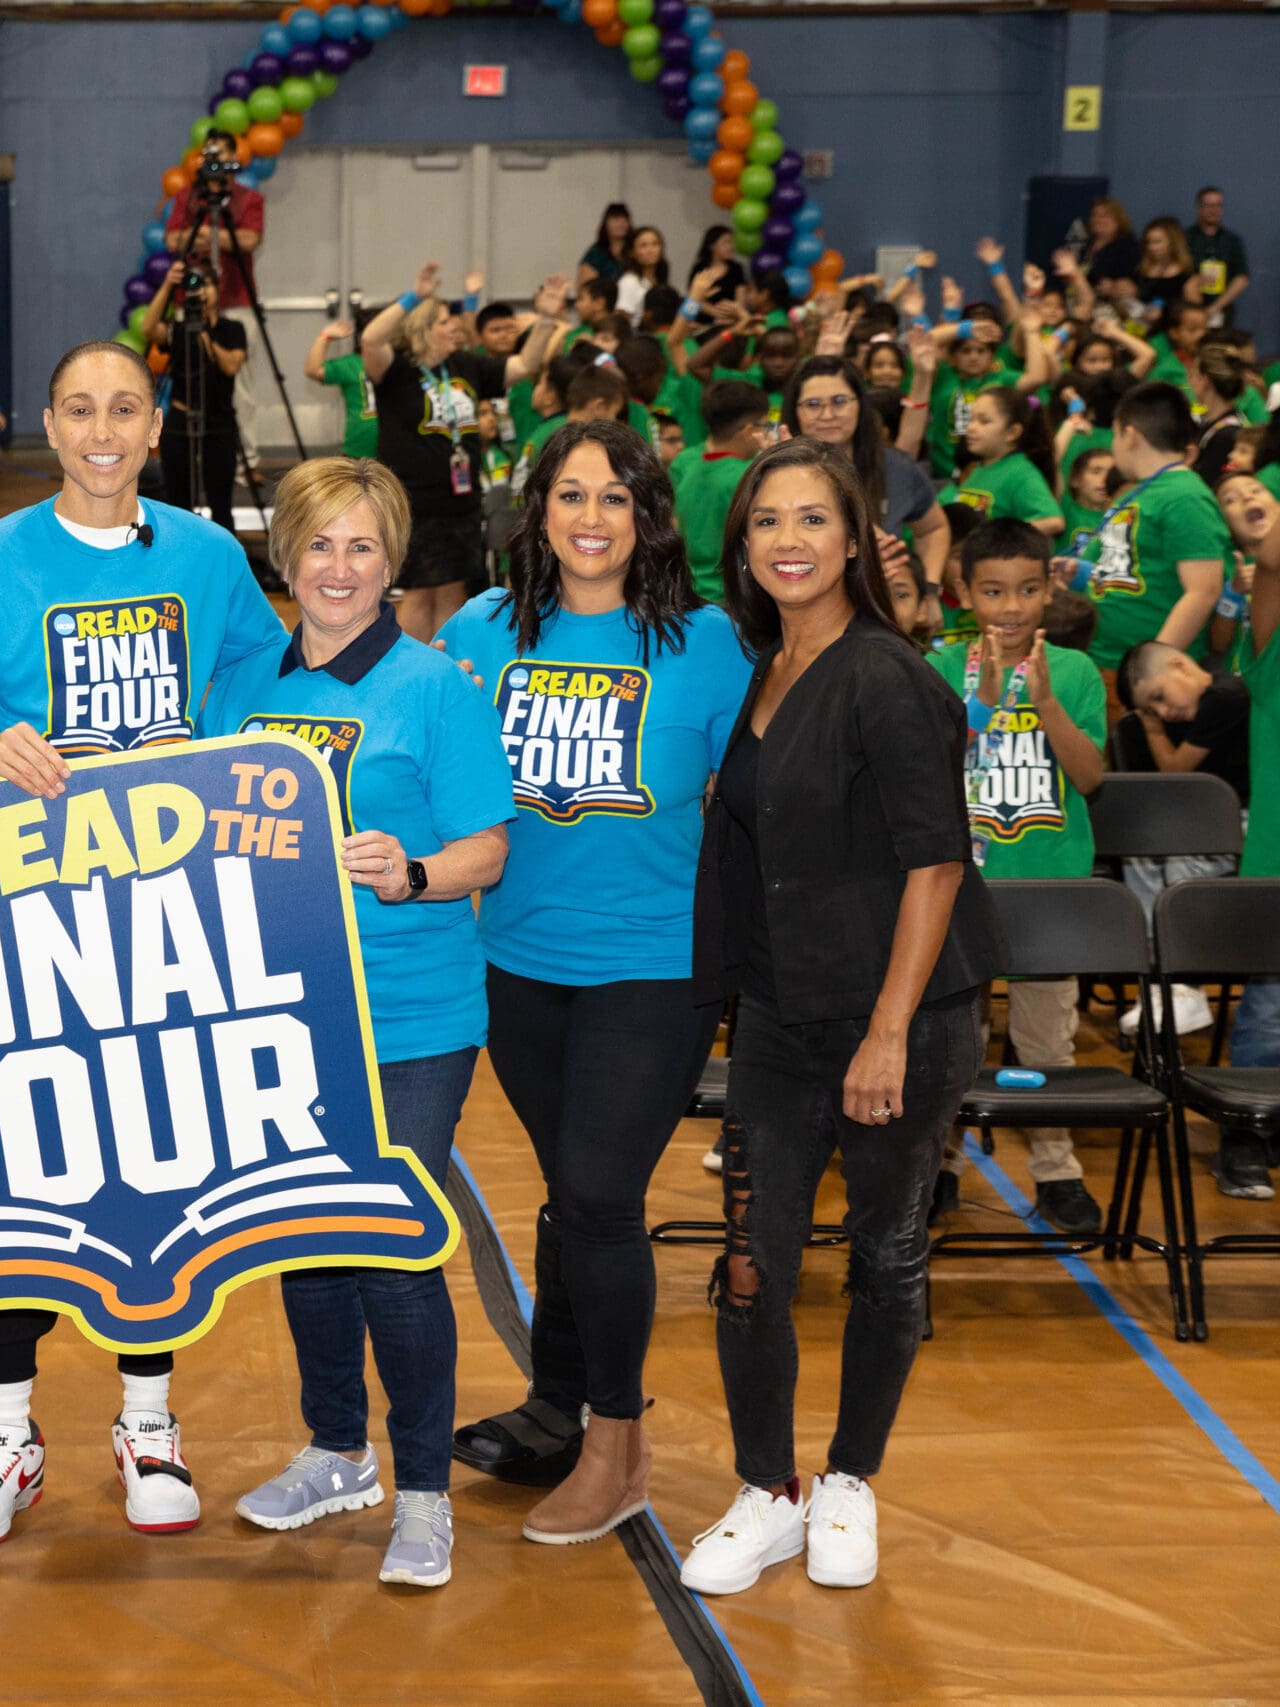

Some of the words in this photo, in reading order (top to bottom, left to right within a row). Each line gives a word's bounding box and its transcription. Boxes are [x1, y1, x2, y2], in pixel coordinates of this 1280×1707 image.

[1073, 98, 1091, 122] 2
[163, 602, 179, 616] TO
[76, 606, 158, 640] READ
[158, 615, 179, 631] THE
[62, 628, 178, 684] FINAL
[527, 669, 612, 699] READ
[610, 684, 639, 702] THE
[621, 673, 642, 688] TO
[65, 675, 180, 732] FOUR
[502, 690, 624, 739] FINAL
[327, 734, 351, 751] THE
[338, 724, 356, 739] TO
[230, 763, 299, 810] TO
[209, 809, 303, 859] THE
